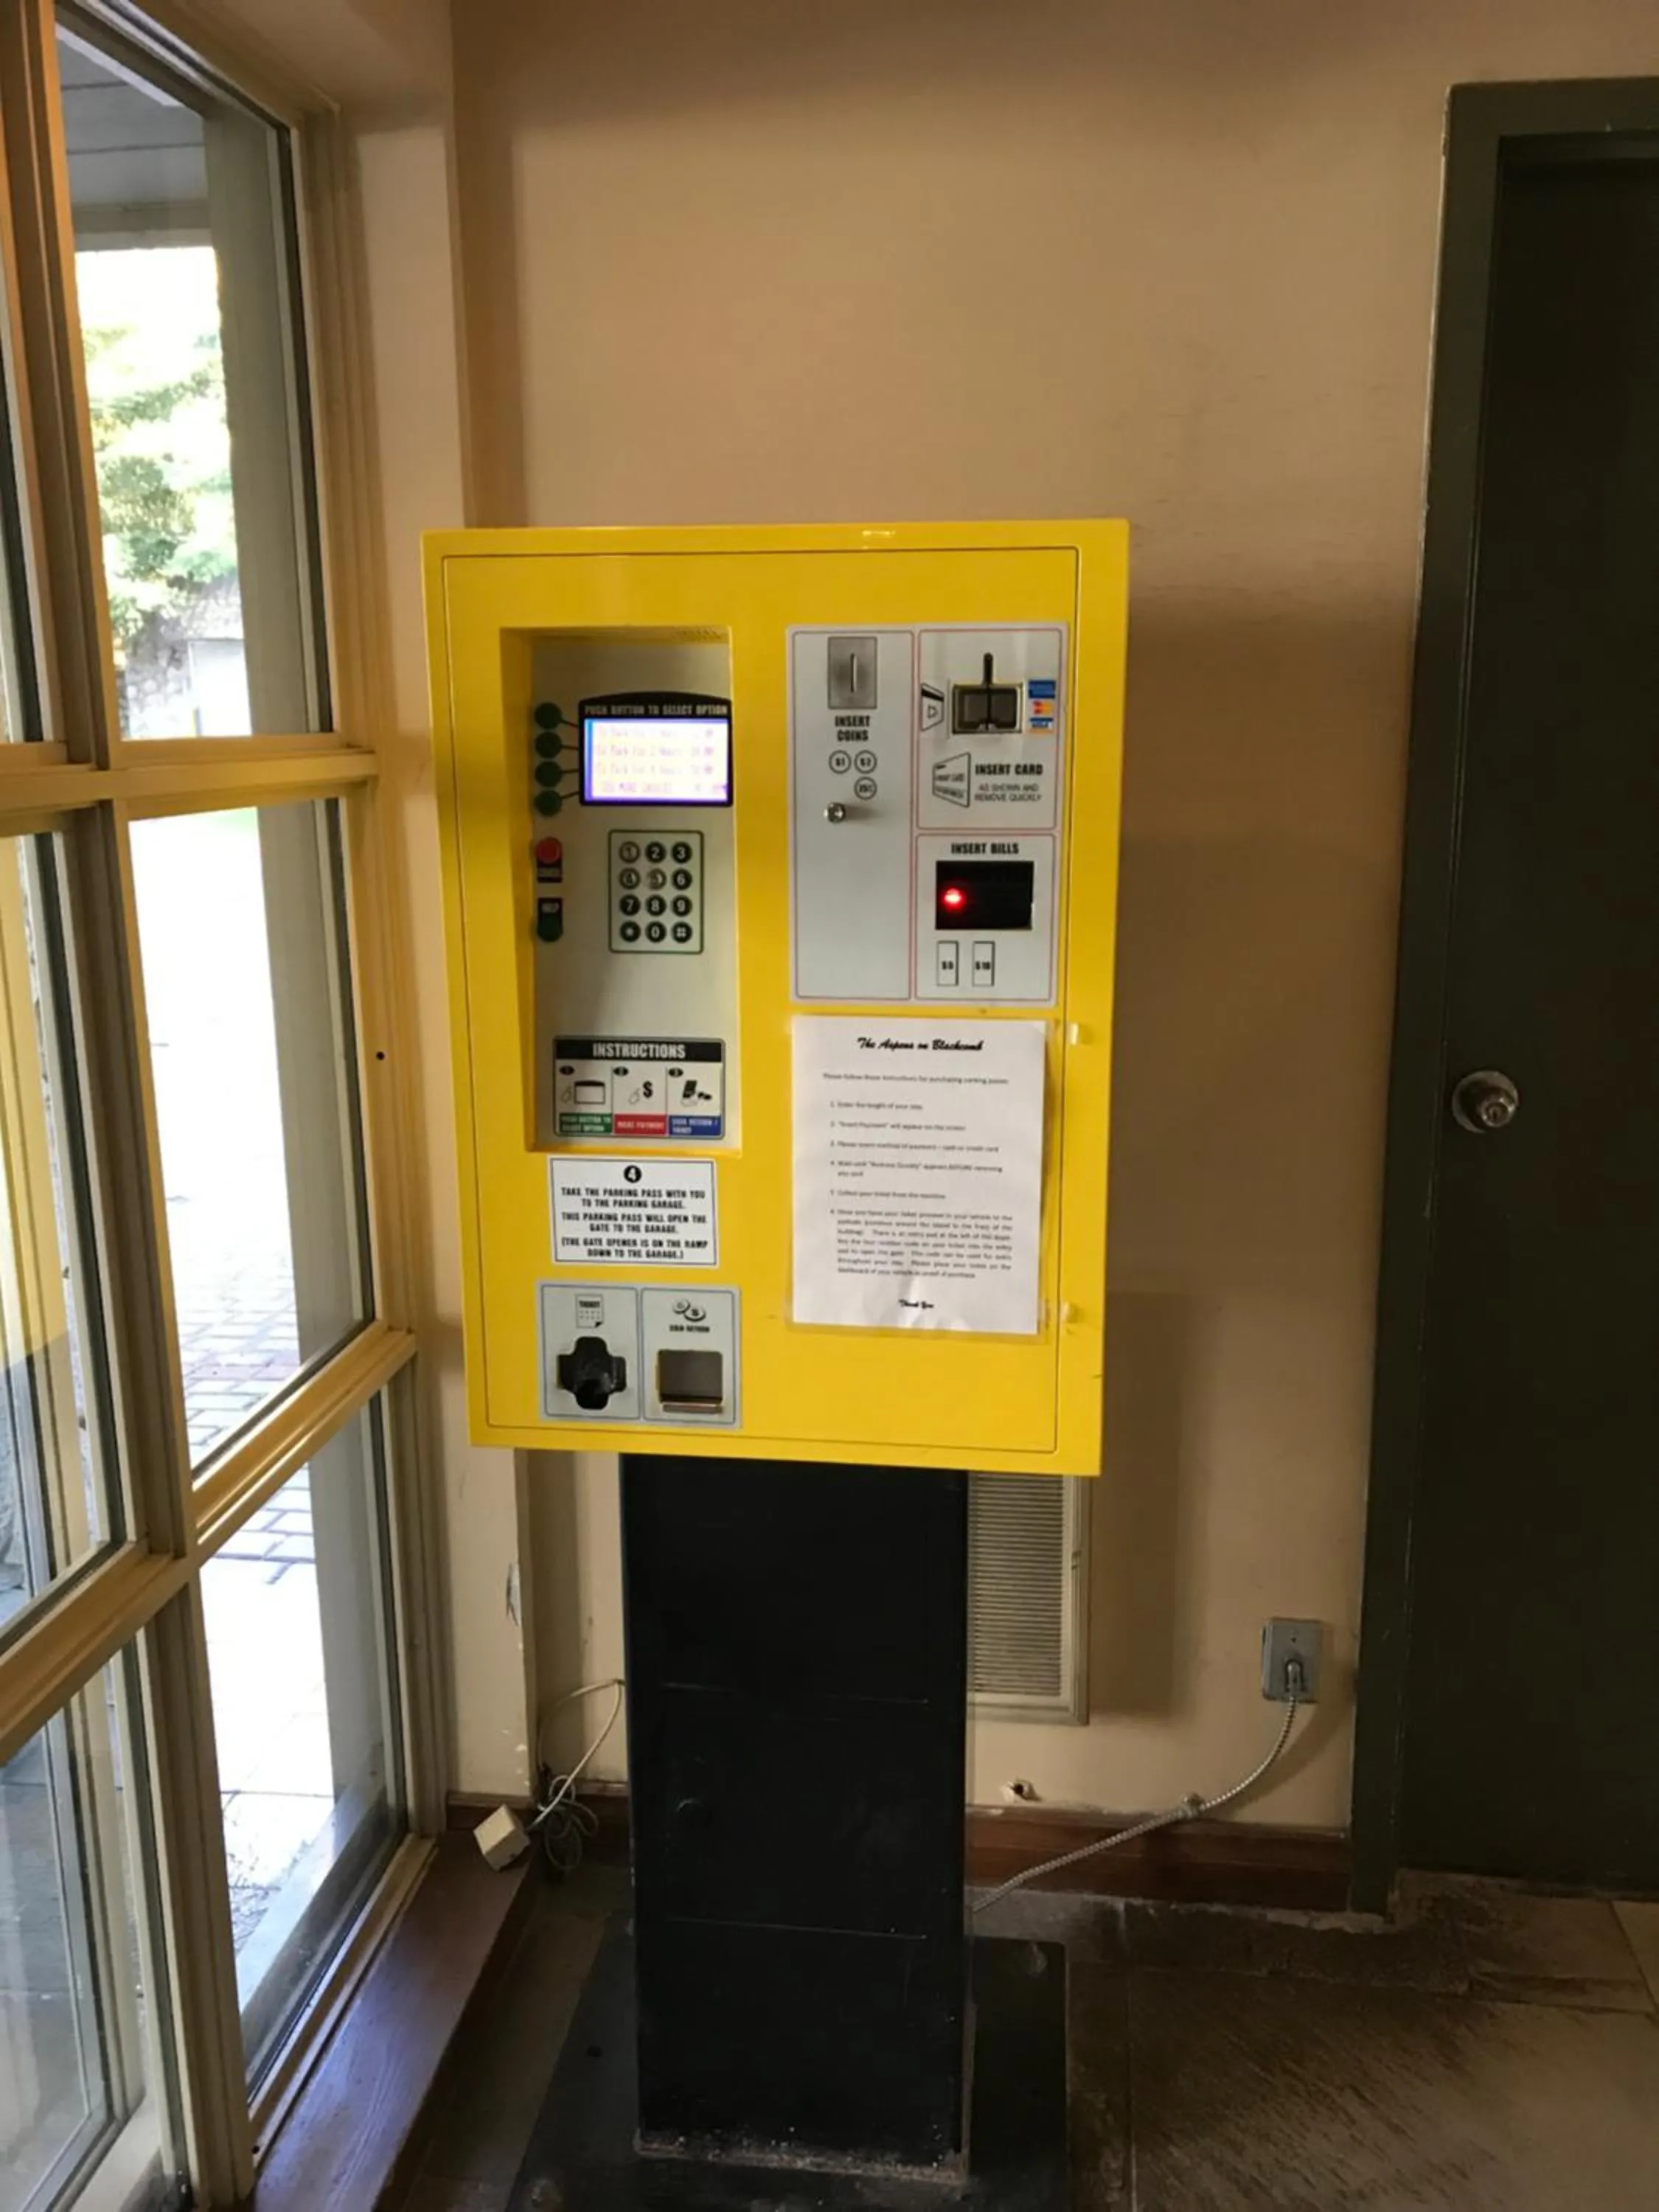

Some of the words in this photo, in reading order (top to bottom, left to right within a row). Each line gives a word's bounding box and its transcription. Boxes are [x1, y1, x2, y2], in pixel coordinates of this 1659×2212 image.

[835, 715, 870, 727] INSERT
[837, 730, 869, 742] COINS
[975, 764, 1011, 775] INSERT
[1015, 764, 1043, 775] CARD
[650, 846, 661, 859] 2
[676, 846, 686, 860] 3
[951, 843, 987, 855] INSERT
[991, 843, 1019, 855] BILLS
[676, 872, 686, 886] 6
[625, 899, 635, 912] 7
[650, 899, 661, 912] 8
[676, 899, 686, 913] 9
[650, 925, 661, 939] 0
[858, 1037, 875, 1049] The
[593, 1043, 686, 1059] INSTRUCTIONS
[627, 1166, 639, 1181] 4
[561, 1187, 581, 1196] TAKE
[585, 1187, 599, 1196] THE
[603, 1188, 638, 1197] PARKING
[641, 1189, 662, 1198] PASS
[667, 1189, 686, 1198] WITH
[690, 1190, 706, 1199] YOU
[582, 1198, 591, 1207] TO
[595, 1199, 609, 1207] THE
[613, 1199, 647, 1208] PARKING
[562, 1212, 580, 1221] THIS
[583, 1213, 618, 1222] PARKING
[622, 1214, 641, 1222] PASS
[646, 1214, 664, 1223] WILL
[667, 1215, 689, 1224] OPEN
[692, 1215, 706, 1225] THE
[590, 1223, 609, 1233] GATE
[613, 1224, 624, 1233] TO
[627, 1225, 641, 1234] THE
[583, 1238, 602, 1247] GATE
[607, 1239, 637, 1248] OPENER
[641, 1239, 649, 1248] IS
[652, 1239, 663, 1248] ON
[667, 1240, 681, 1248] THE
[684, 1241, 708, 1250] RAMP
[588, 1249, 611, 1258] DOWN
[615, 1249, 625, 1259] TO
[628, 1250, 642, 1259] THE
